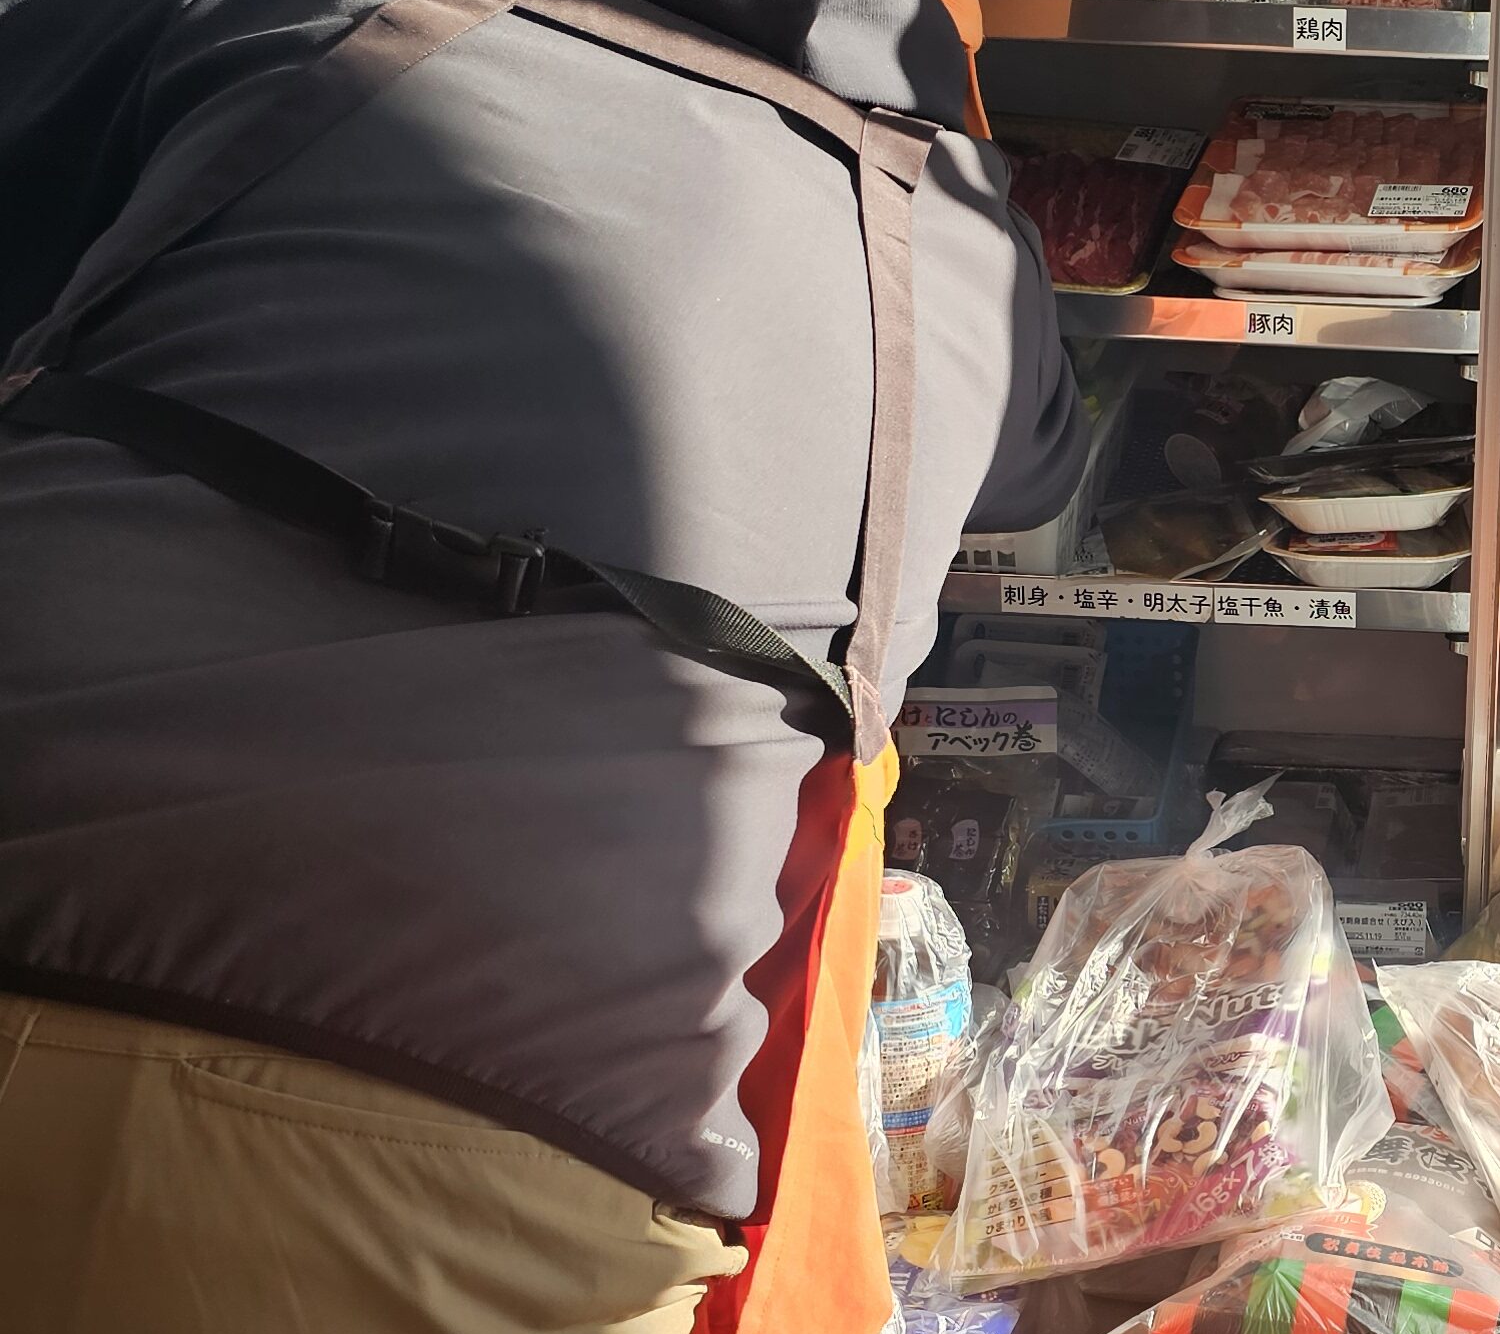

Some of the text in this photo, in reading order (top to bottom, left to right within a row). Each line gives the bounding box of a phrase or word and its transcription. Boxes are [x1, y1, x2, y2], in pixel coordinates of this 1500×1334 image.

[1296, 17, 1343, 42] 鶏肉
[1247, 312, 1294, 335] 豚肉
[1003, 583, 1211, 616] 刺身・塩辛・明太子
[1217, 595, 1354, 621] 塩干魚・漬魚
[927, 720, 1042, 753] アベック巻
[723, 1137, 754, 1160] DRY
